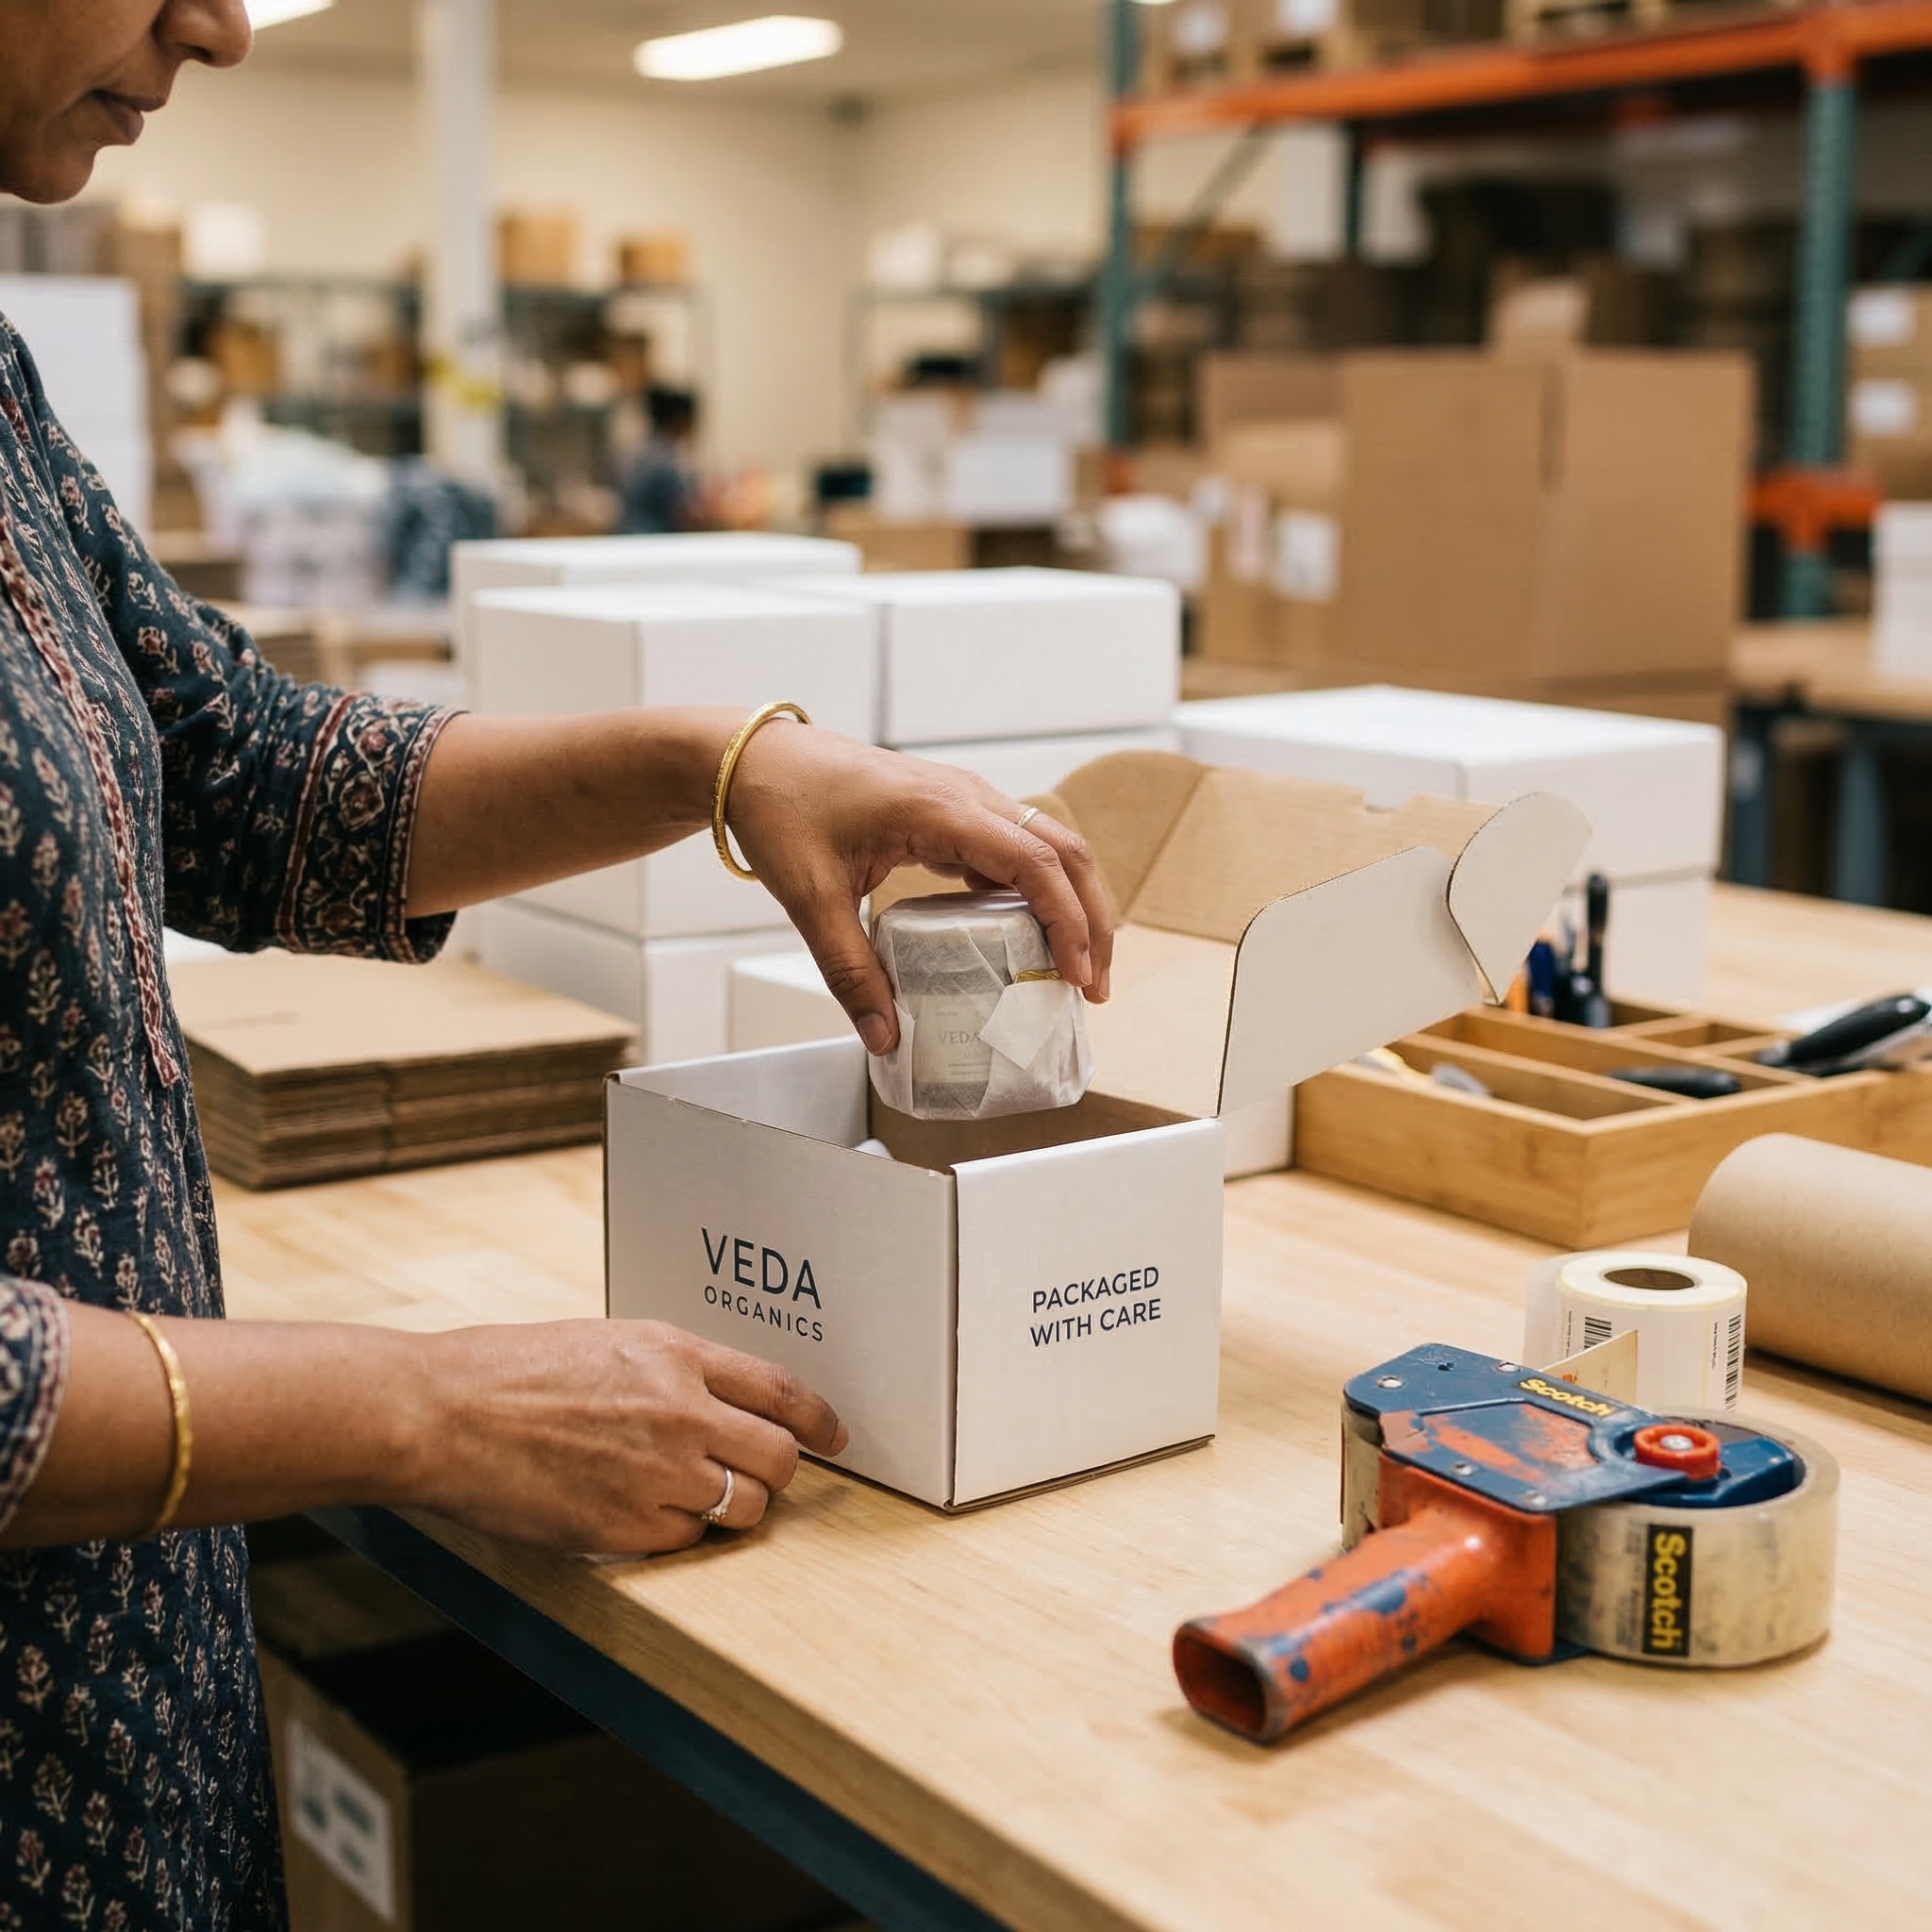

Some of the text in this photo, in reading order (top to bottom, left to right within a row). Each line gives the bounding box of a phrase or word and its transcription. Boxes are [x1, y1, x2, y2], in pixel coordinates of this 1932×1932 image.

[700, 1226, 823, 1310] VEDA
[1033, 1266, 1159, 1314] PACKAGED
[704, 1285, 824, 1342] ORGANICS
[1029, 1298, 1161, 1348] WITH CARE
[1520, 1378, 1611, 1416] Scotch
[1652, 1532, 1688, 1649] Scotch
